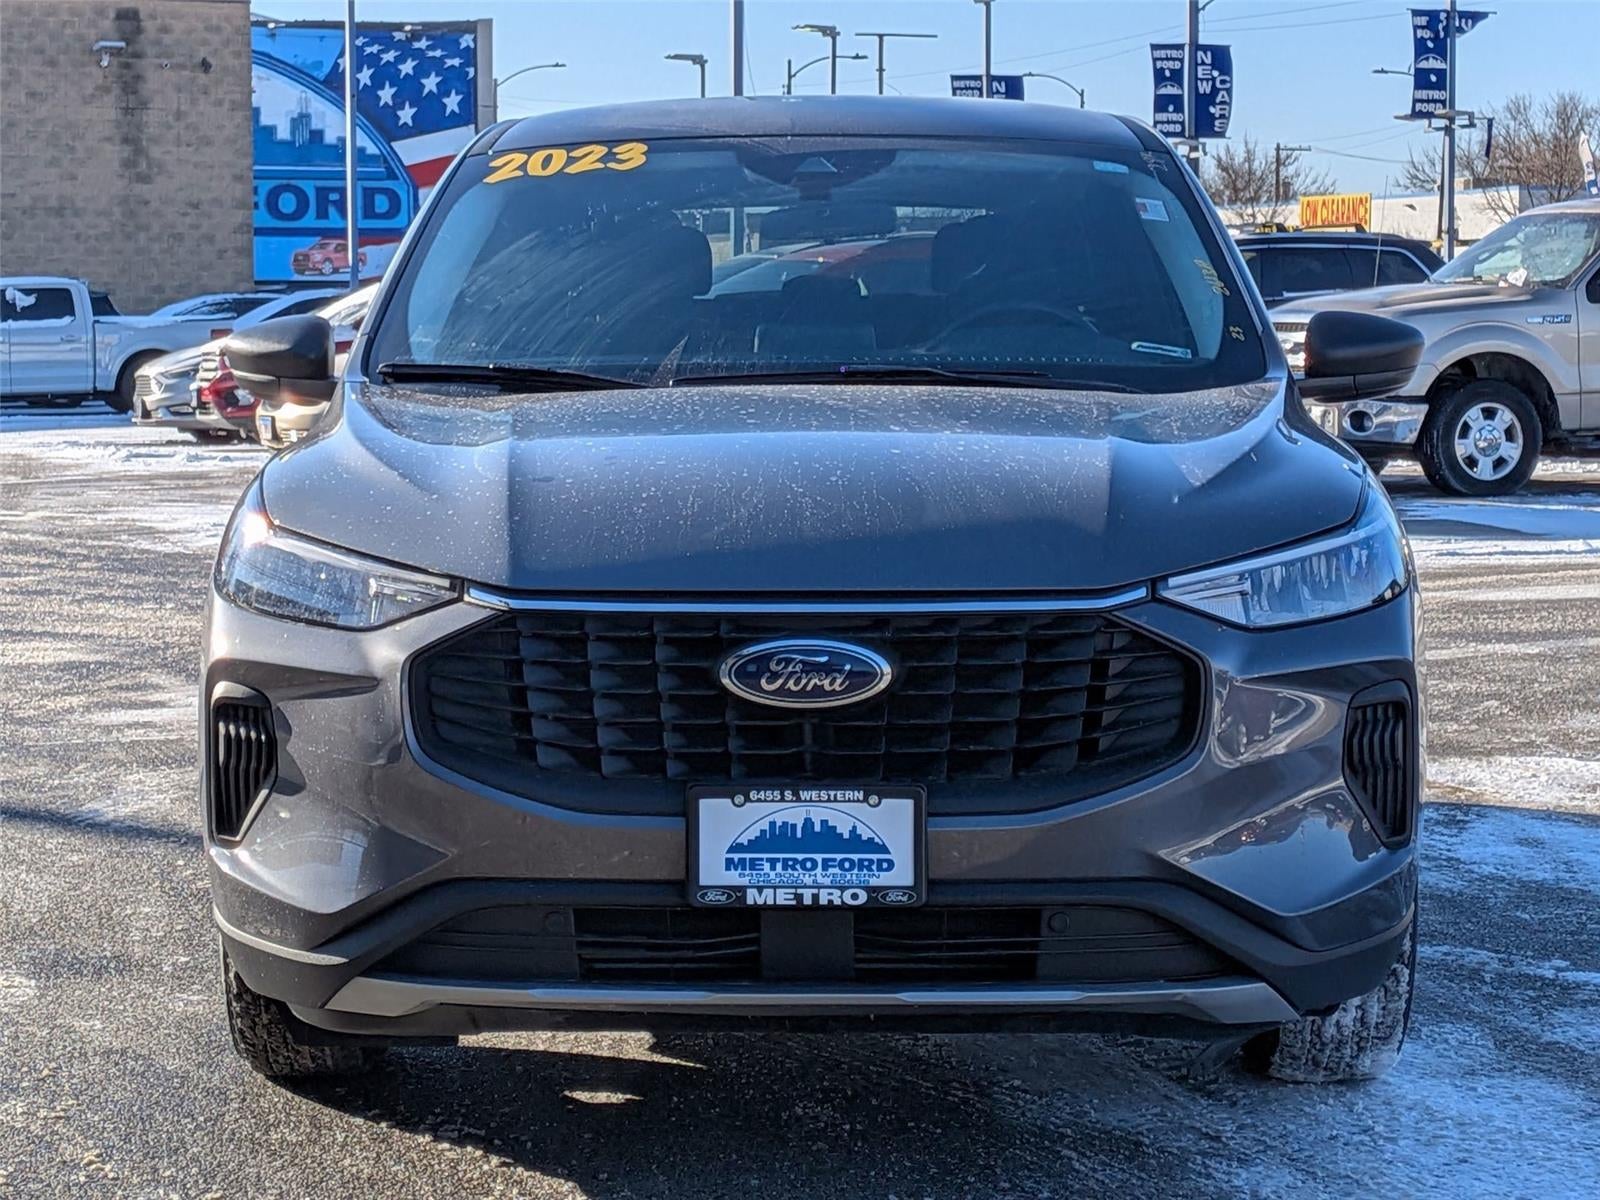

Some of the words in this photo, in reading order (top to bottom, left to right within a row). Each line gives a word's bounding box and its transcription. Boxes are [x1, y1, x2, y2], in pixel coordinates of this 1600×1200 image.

[1153, 50, 1183, 58] METRO
[1156, 61, 1181, 69] FORD
[1197, 51, 1212, 94] NEW
[1414, 90, 1446, 100] METRO
[1214, 75, 1231, 132] CARS
[1155, 113, 1183, 121] METRO
[1156, 124, 1182, 132] FORD
[482, 141, 649, 184] 2023
[254, 183, 402, 221] ORD
[1301, 199, 1318, 227] LOW
[1320, 195, 1368, 226] CLEARANCE
[760, 654, 852, 692] Ford
[749, 790, 781, 801] 6455
[784, 790, 796, 801] S.
[799, 790, 864, 801] WESTERN
[725, 857, 819, 872] METRO
[821, 857, 896, 872] FORD
[748, 878, 807, 887] CHICAGO,
[704, 891, 728, 901] Ford
[746, 888, 868, 905] METRO
[885, 892, 909, 901] Ford
